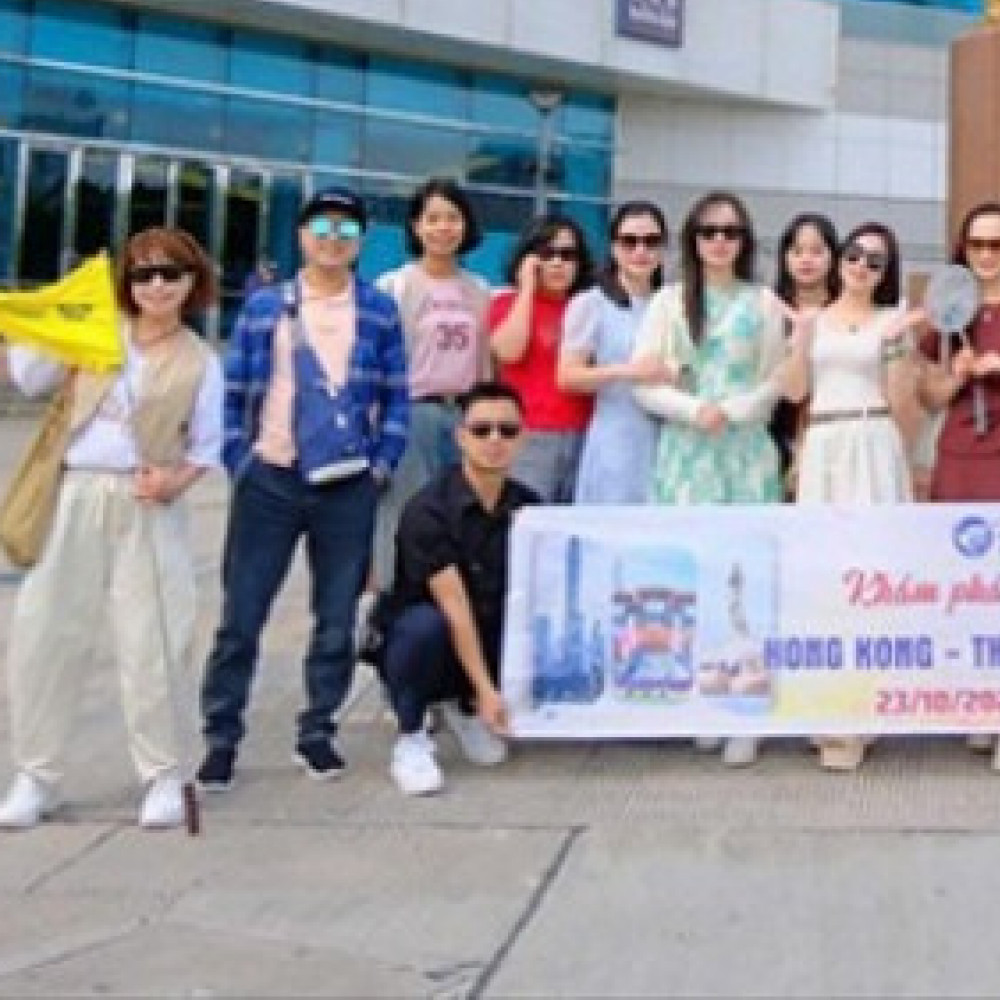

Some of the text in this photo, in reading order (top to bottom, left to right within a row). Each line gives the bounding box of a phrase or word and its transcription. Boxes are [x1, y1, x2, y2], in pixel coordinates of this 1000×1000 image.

[437, 321, 470, 352] 35
[763, 635, 844, 670] HONG
[855, 634, 934, 670] KONG
